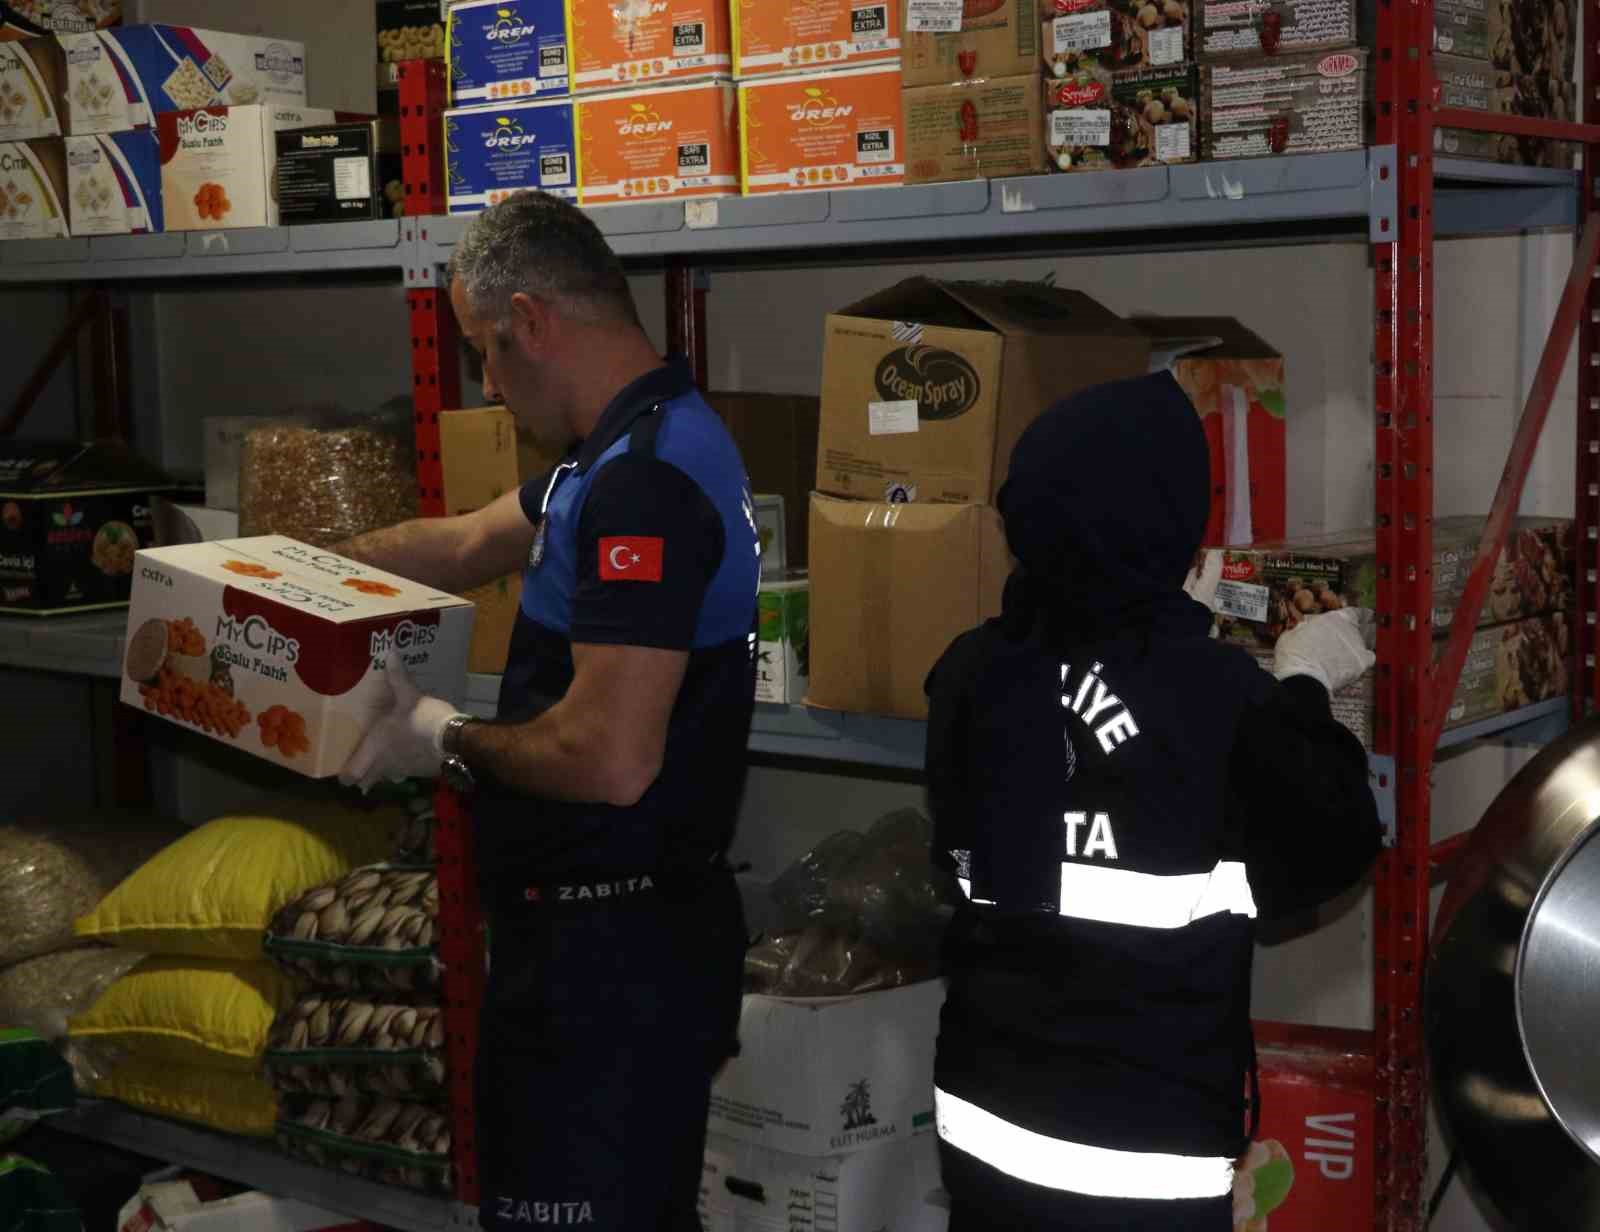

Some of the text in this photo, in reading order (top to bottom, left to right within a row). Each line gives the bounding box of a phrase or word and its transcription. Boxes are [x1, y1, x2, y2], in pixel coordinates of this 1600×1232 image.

[881, 365, 965, 410] Ocean Spray
[141, 566, 174, 587] extra
[559, 874, 654, 900] ZABITA
[1303, 1112, 1356, 1180] VIP
[496, 1193, 593, 1224] ZABITA
